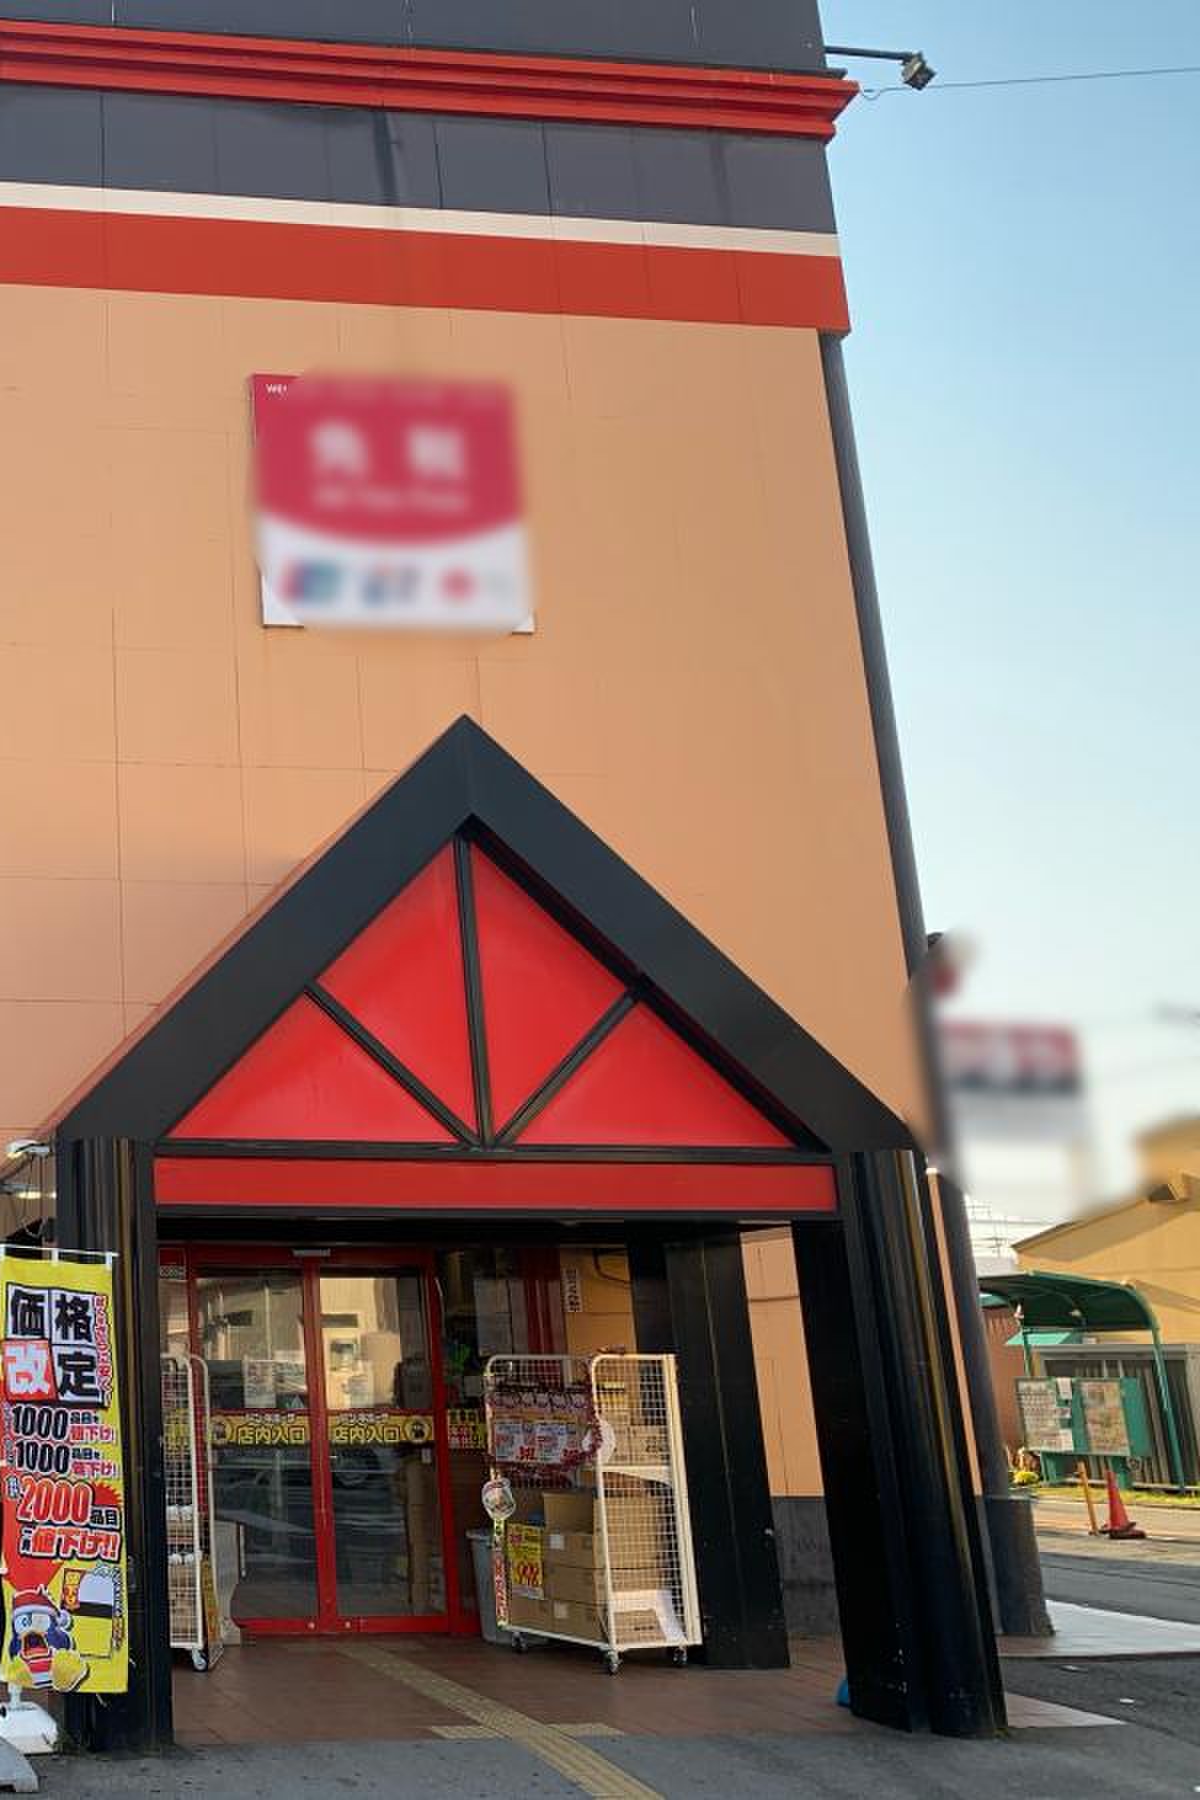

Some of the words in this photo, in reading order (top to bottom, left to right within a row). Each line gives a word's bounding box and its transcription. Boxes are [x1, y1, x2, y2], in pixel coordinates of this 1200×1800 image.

[11, 1289, 92, 1342] 価格
[6, 1344, 101, 1397] 改定
[238, 1426, 305, 1444] 店内入口
[334, 1426, 401, 1444] 店内入口
[17, 1477, 93, 1524] 2000
